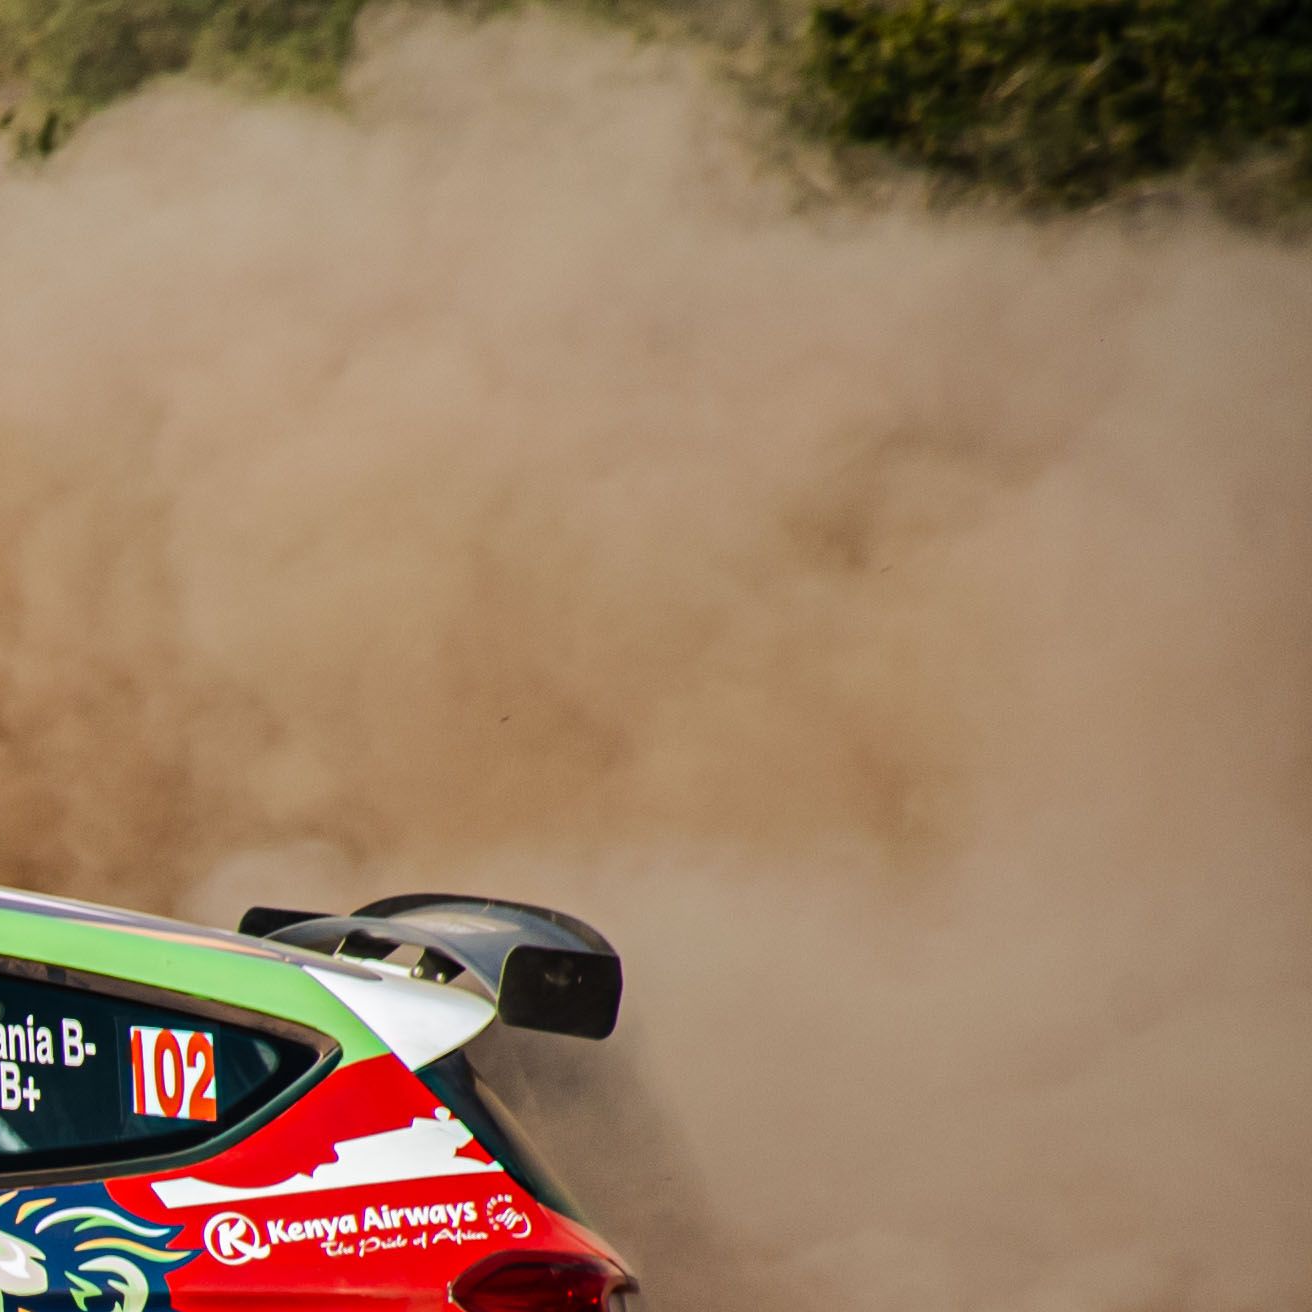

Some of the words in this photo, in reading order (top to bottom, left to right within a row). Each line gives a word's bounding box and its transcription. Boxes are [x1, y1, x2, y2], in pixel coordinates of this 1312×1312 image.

[61, 1018, 96, 1067] B-
[0, 1061, 41, 1112] B+
[130, 1027, 217, 1121] 102
[268, 1211, 357, 1245] Kenya
[363, 1201, 477, 1231] Airways
[320, 1239, 355, 1257] The
[412, 1232, 427, 1249] of
